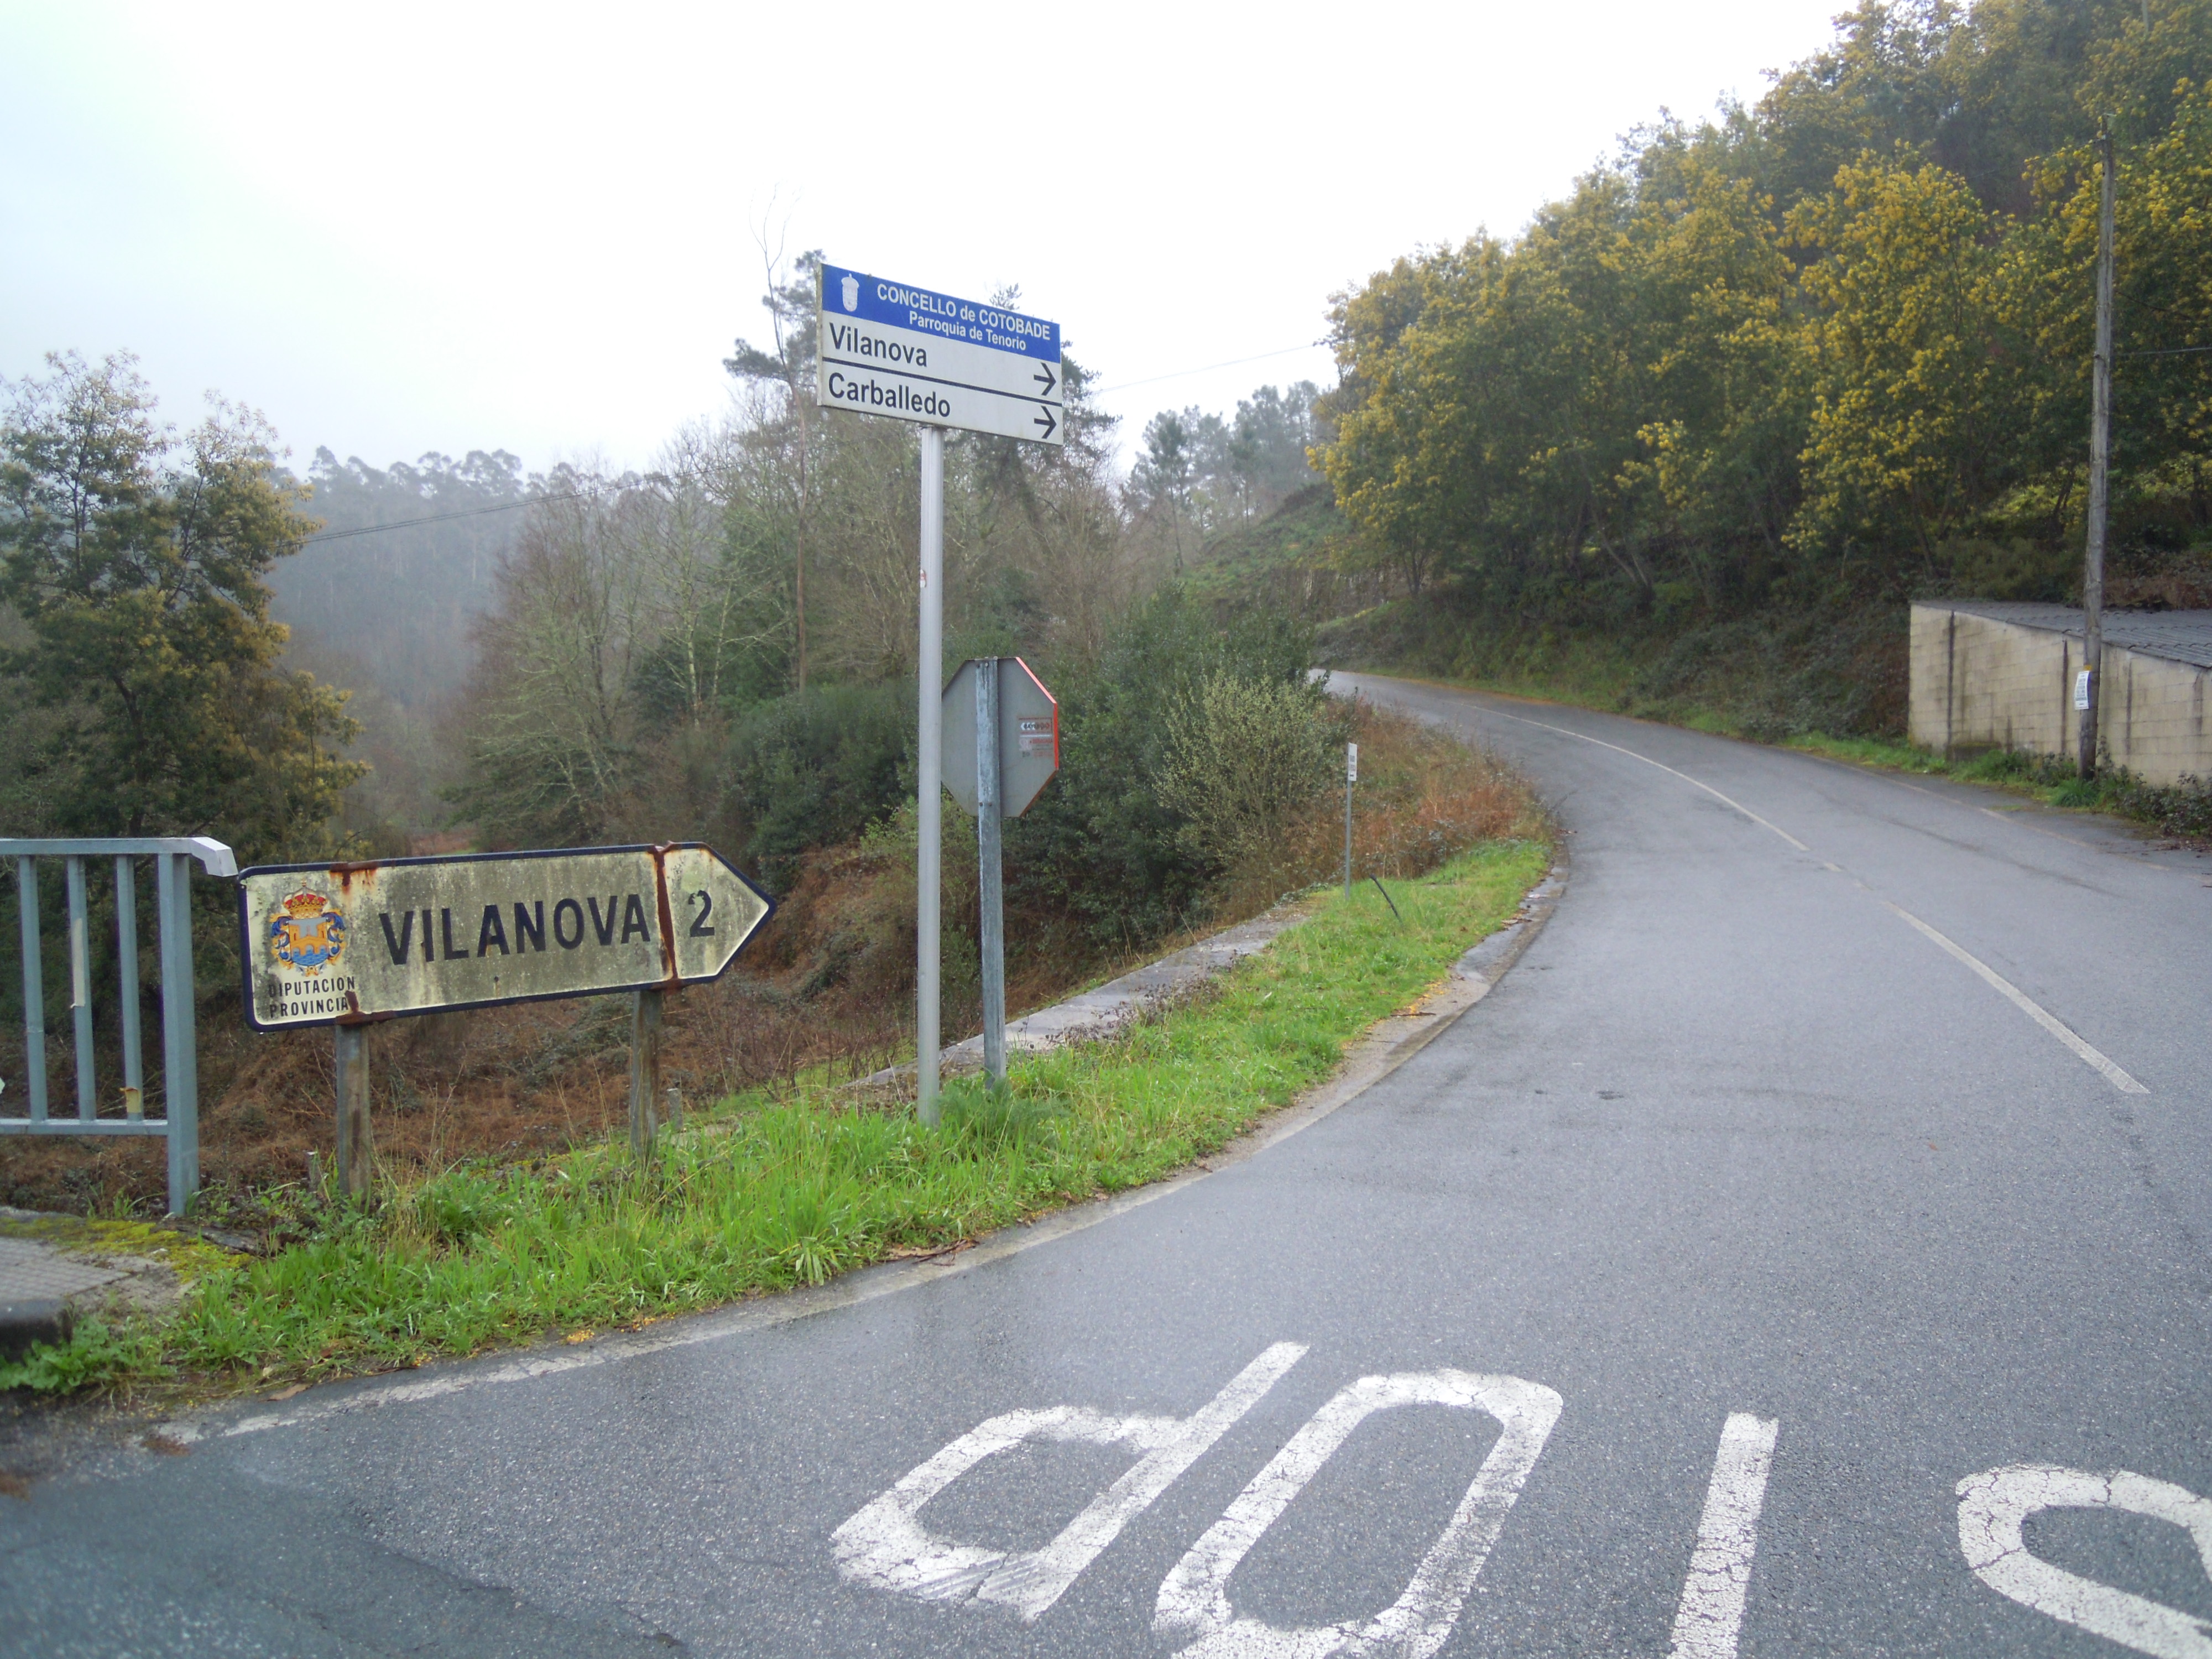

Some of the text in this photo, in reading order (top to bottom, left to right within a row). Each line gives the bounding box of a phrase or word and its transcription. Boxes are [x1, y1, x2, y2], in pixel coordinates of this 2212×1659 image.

[877, 284, 1051, 341] CONCELLO de COTOBADE
[909, 310, 1026, 351] Parroquia de Tenorio
[830, 322, 927, 367] Vilanova
[829, 372, 951, 418] Carballedo
[379, 889, 716, 965] VILANOVA 2
[269, 976, 355, 998] DIPUTACION
[269, 996, 357, 1018] PROVINCIA
